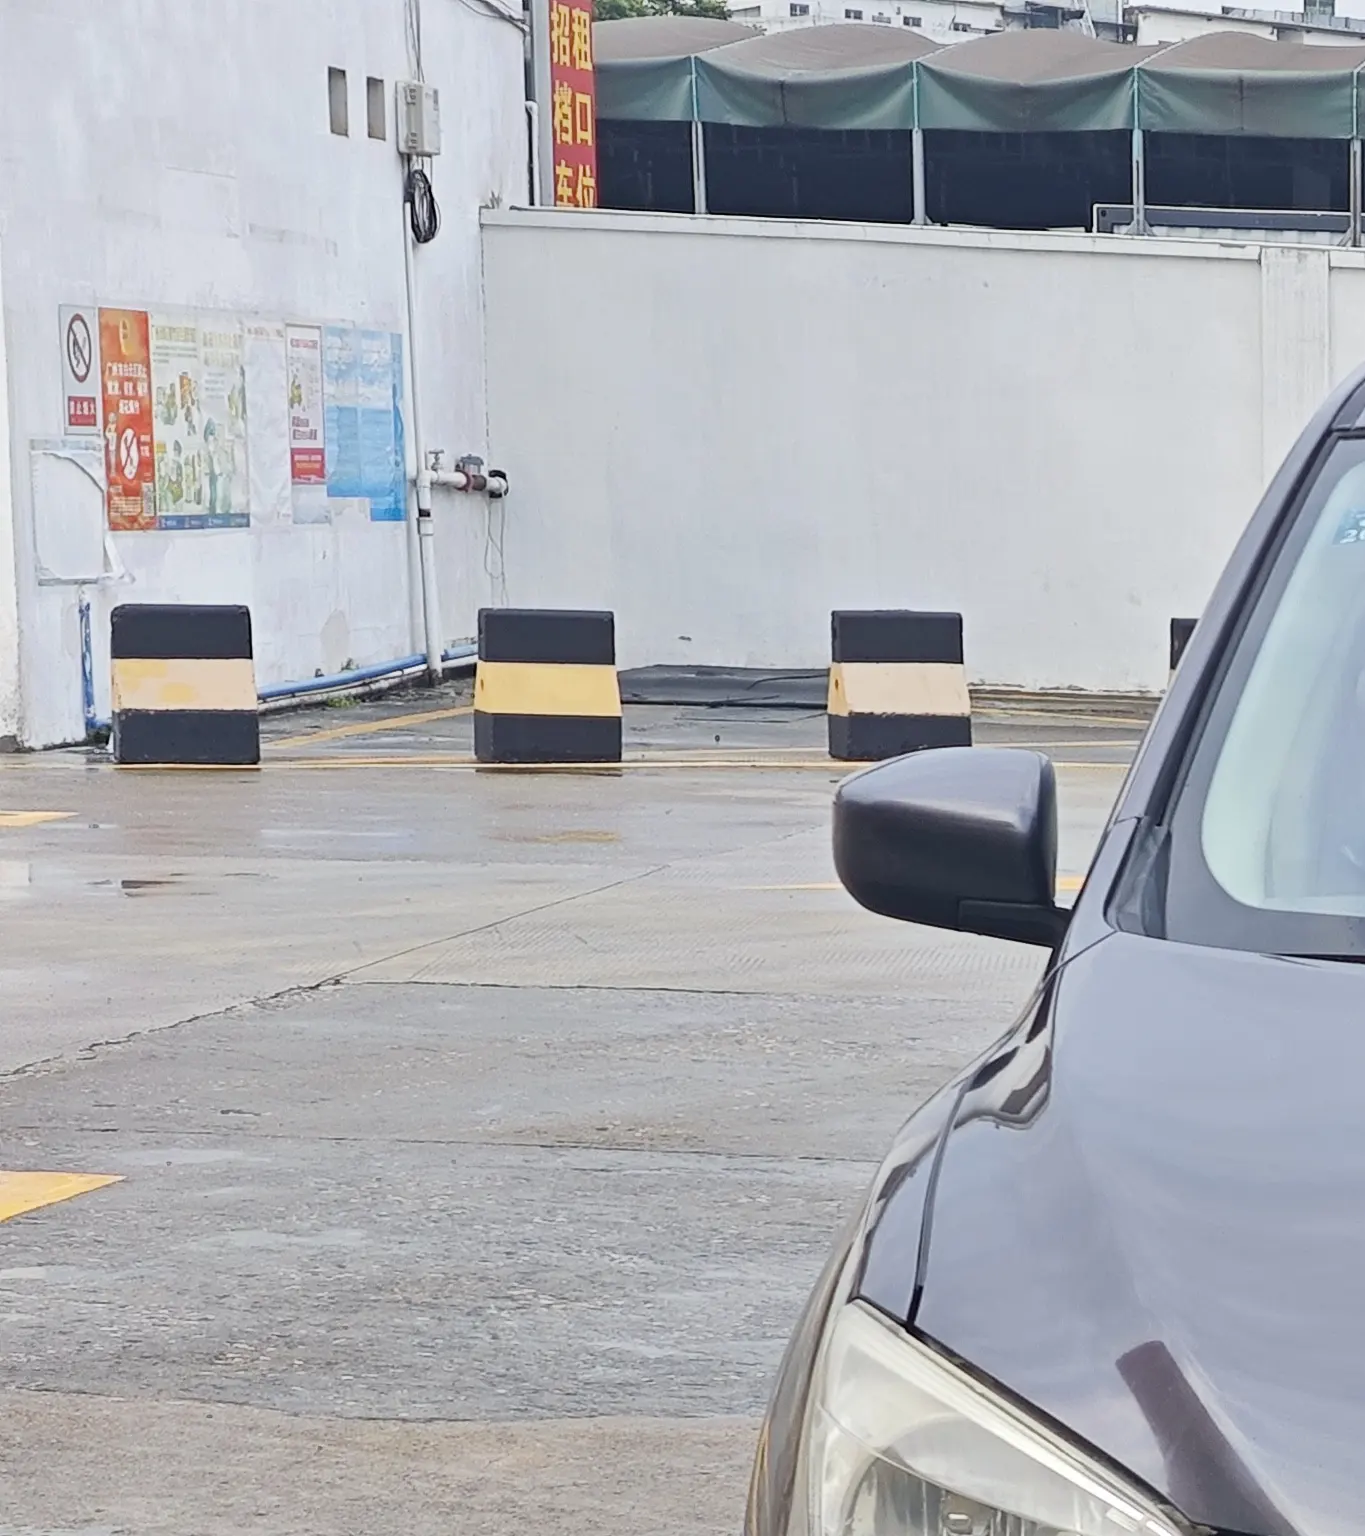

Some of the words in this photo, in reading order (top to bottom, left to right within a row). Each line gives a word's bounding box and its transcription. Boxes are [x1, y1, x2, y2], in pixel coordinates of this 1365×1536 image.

[551, 2, 592, 71] 招租
[554, 80, 592, 146] 档口
[556, 160, 595, 207] 车位
